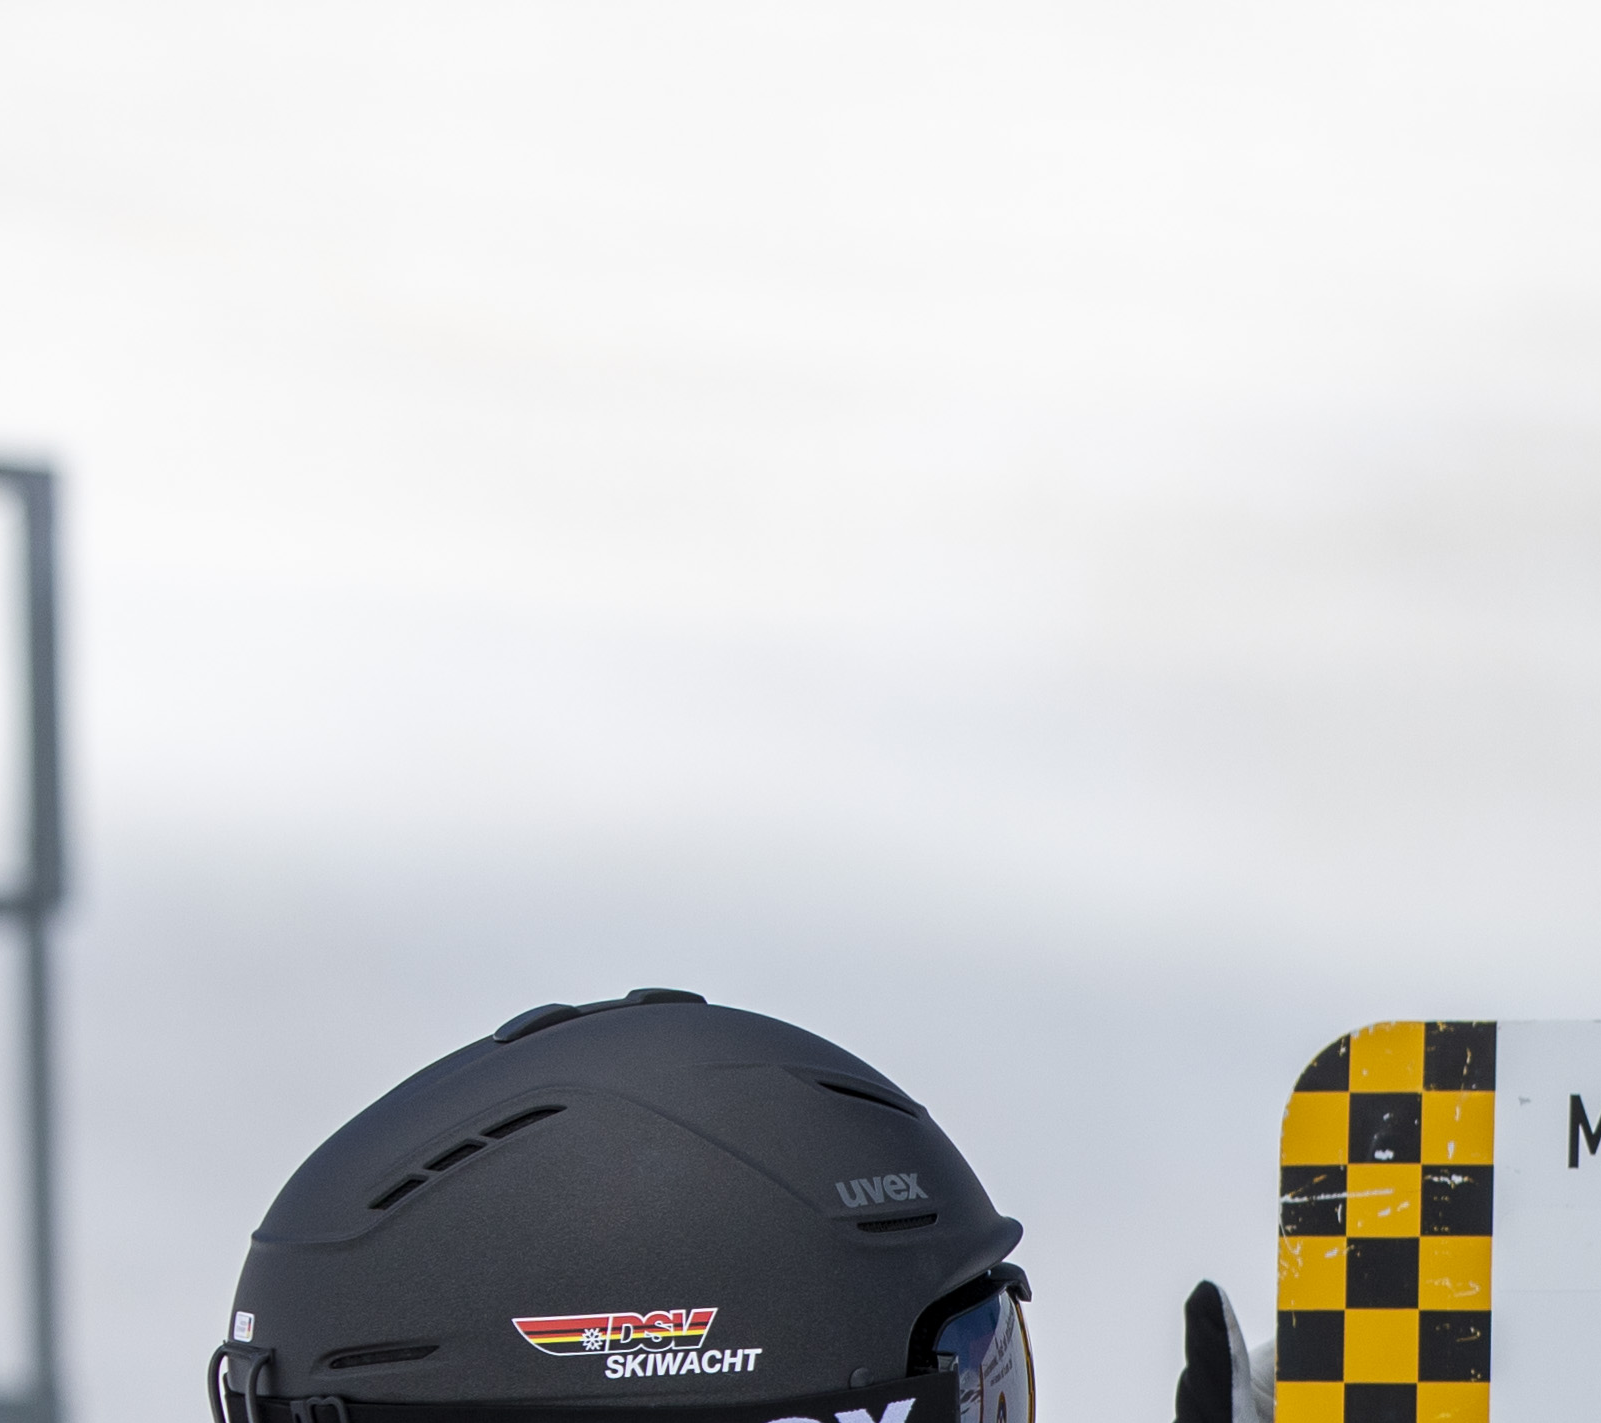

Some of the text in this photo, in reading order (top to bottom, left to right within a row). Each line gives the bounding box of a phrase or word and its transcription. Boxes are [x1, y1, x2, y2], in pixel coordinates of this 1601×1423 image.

[835, 1172, 929, 1209] uvex
[606, 1307, 718, 1352] DSV
[604, 1347, 763, 1379] SKIWACHT
